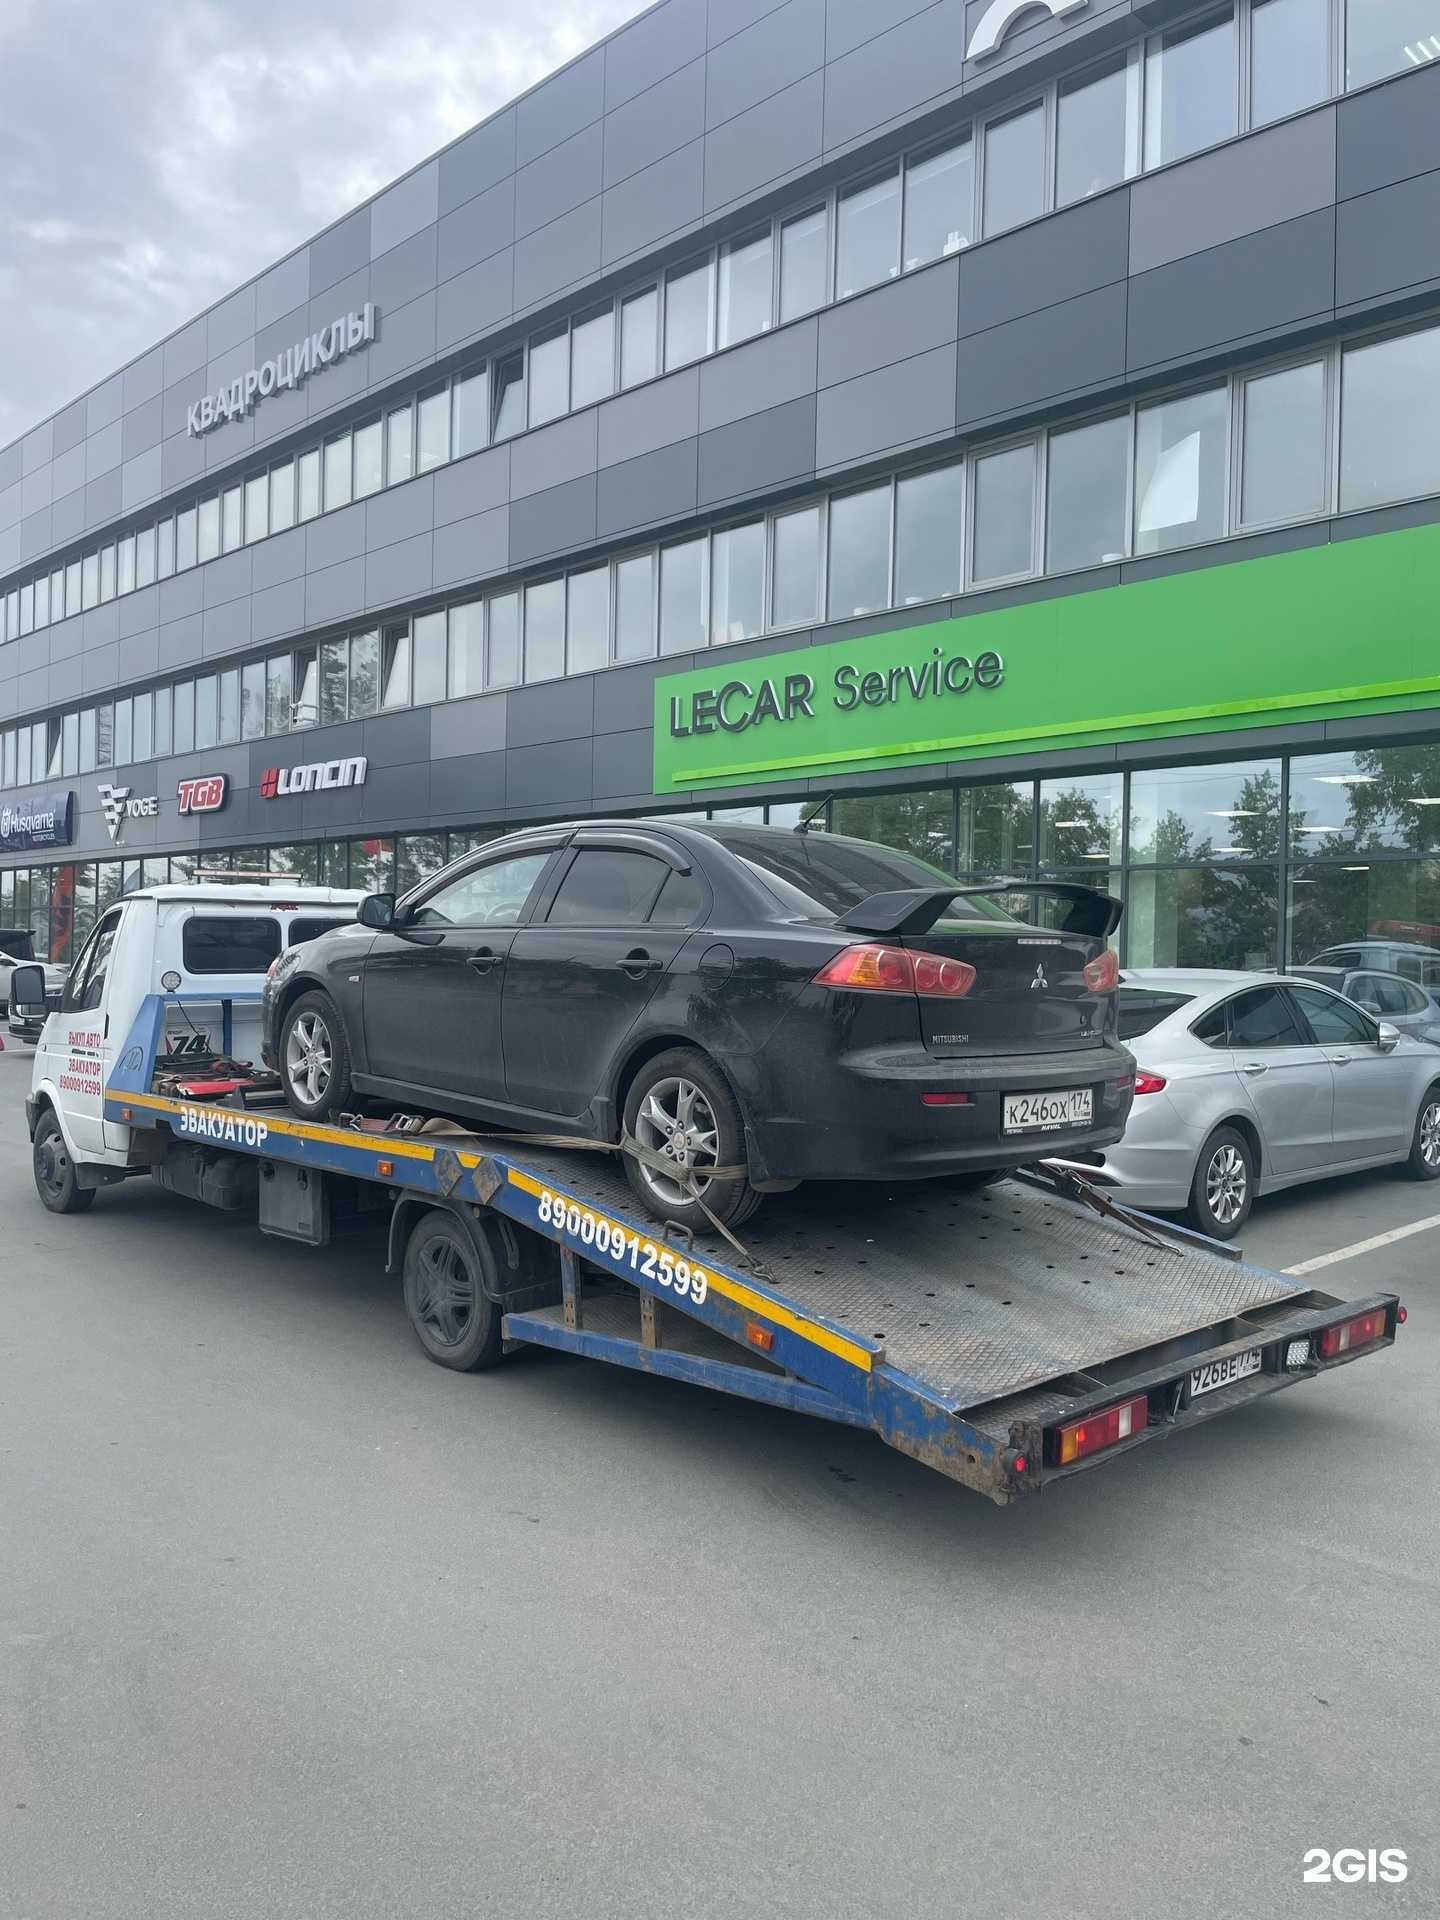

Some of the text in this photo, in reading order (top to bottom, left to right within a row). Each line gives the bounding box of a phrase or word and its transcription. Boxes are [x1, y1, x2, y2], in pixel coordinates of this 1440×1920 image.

[187, 302, 376, 437] КВАДРОЦИКЛЫ
[670, 647, 1004, 738] LECAR Service
[126, 796, 159, 817] VOGE
[178, 776, 225, 813] TGB
[86, 1033, 101, 1047] АВТО
[68, 1058, 101, 1076] ЭВАКУАТОР
[180, 1106, 268, 1147] ЭВАКУАТОР
[537, 1191, 708, 1305] 89000912599
